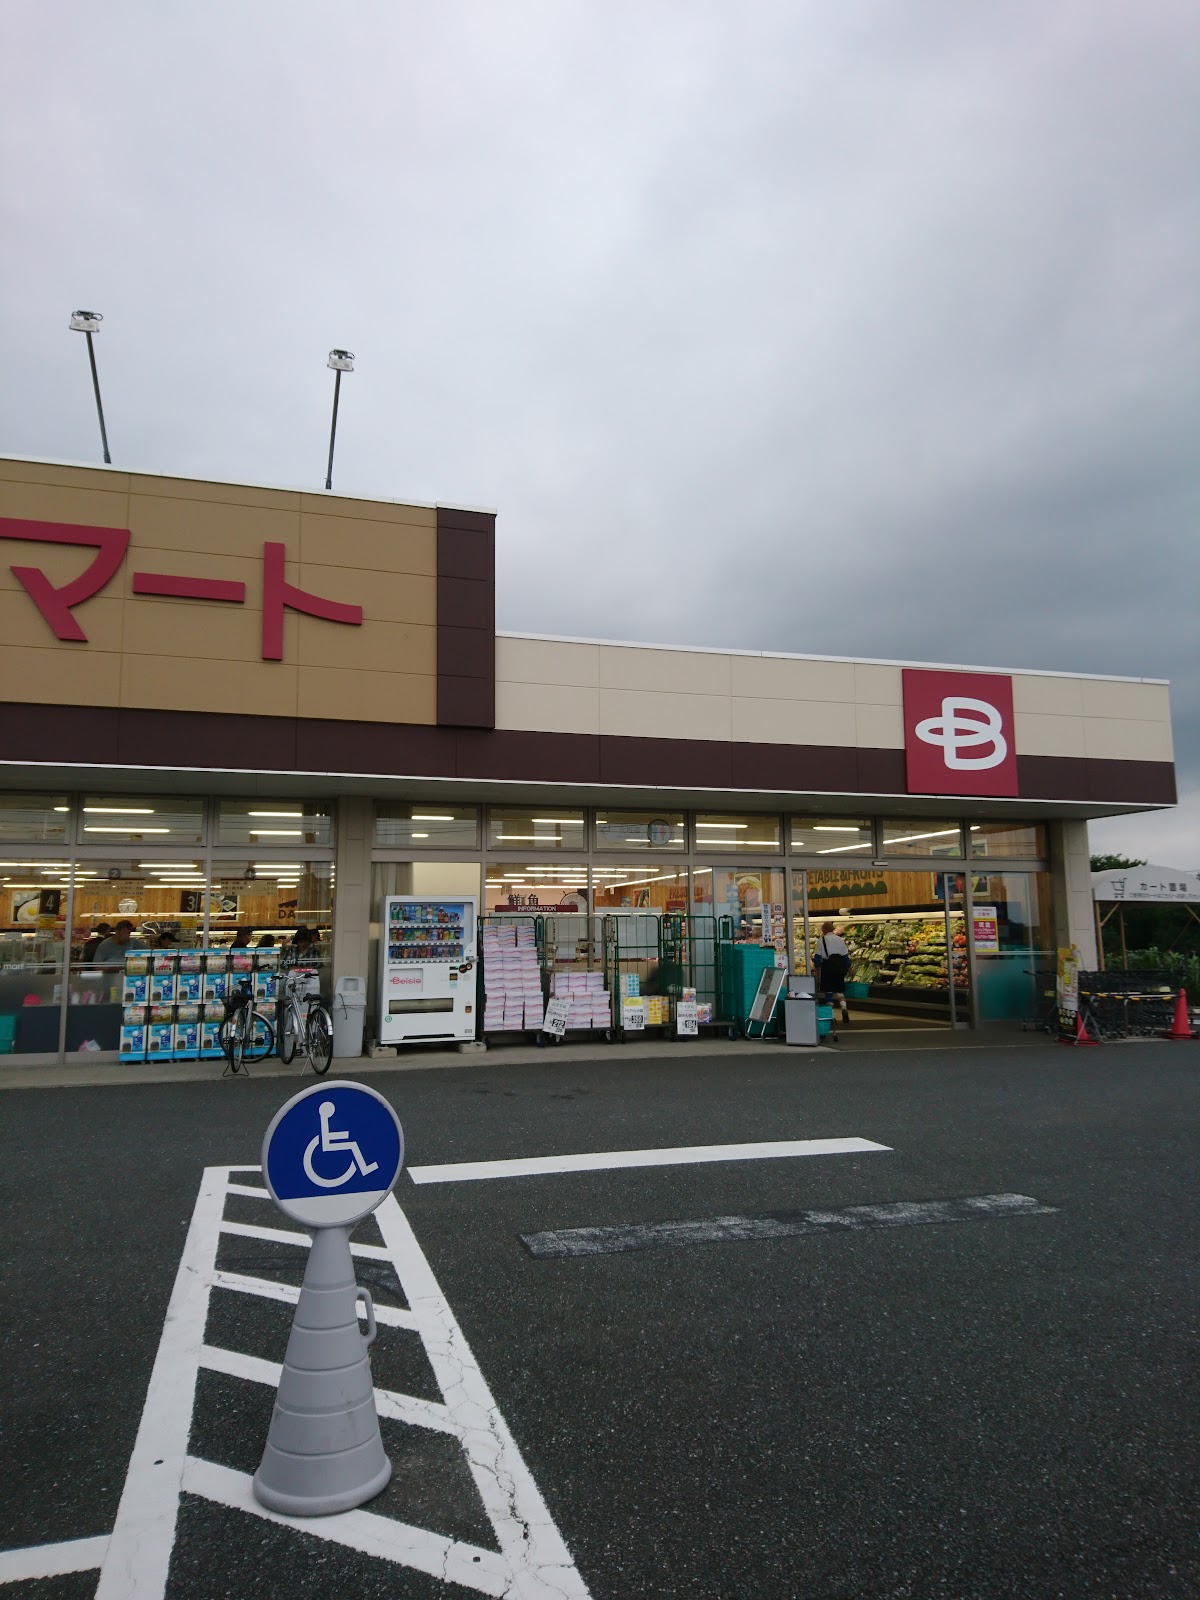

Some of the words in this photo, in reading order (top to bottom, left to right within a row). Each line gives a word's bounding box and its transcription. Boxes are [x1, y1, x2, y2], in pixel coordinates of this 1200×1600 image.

[0, 516, 362, 661] マート
[1140, 882, 1187, 892] カート置場
[45, 894, 54, 910] 4
[186, 895, 195, 911] 3
